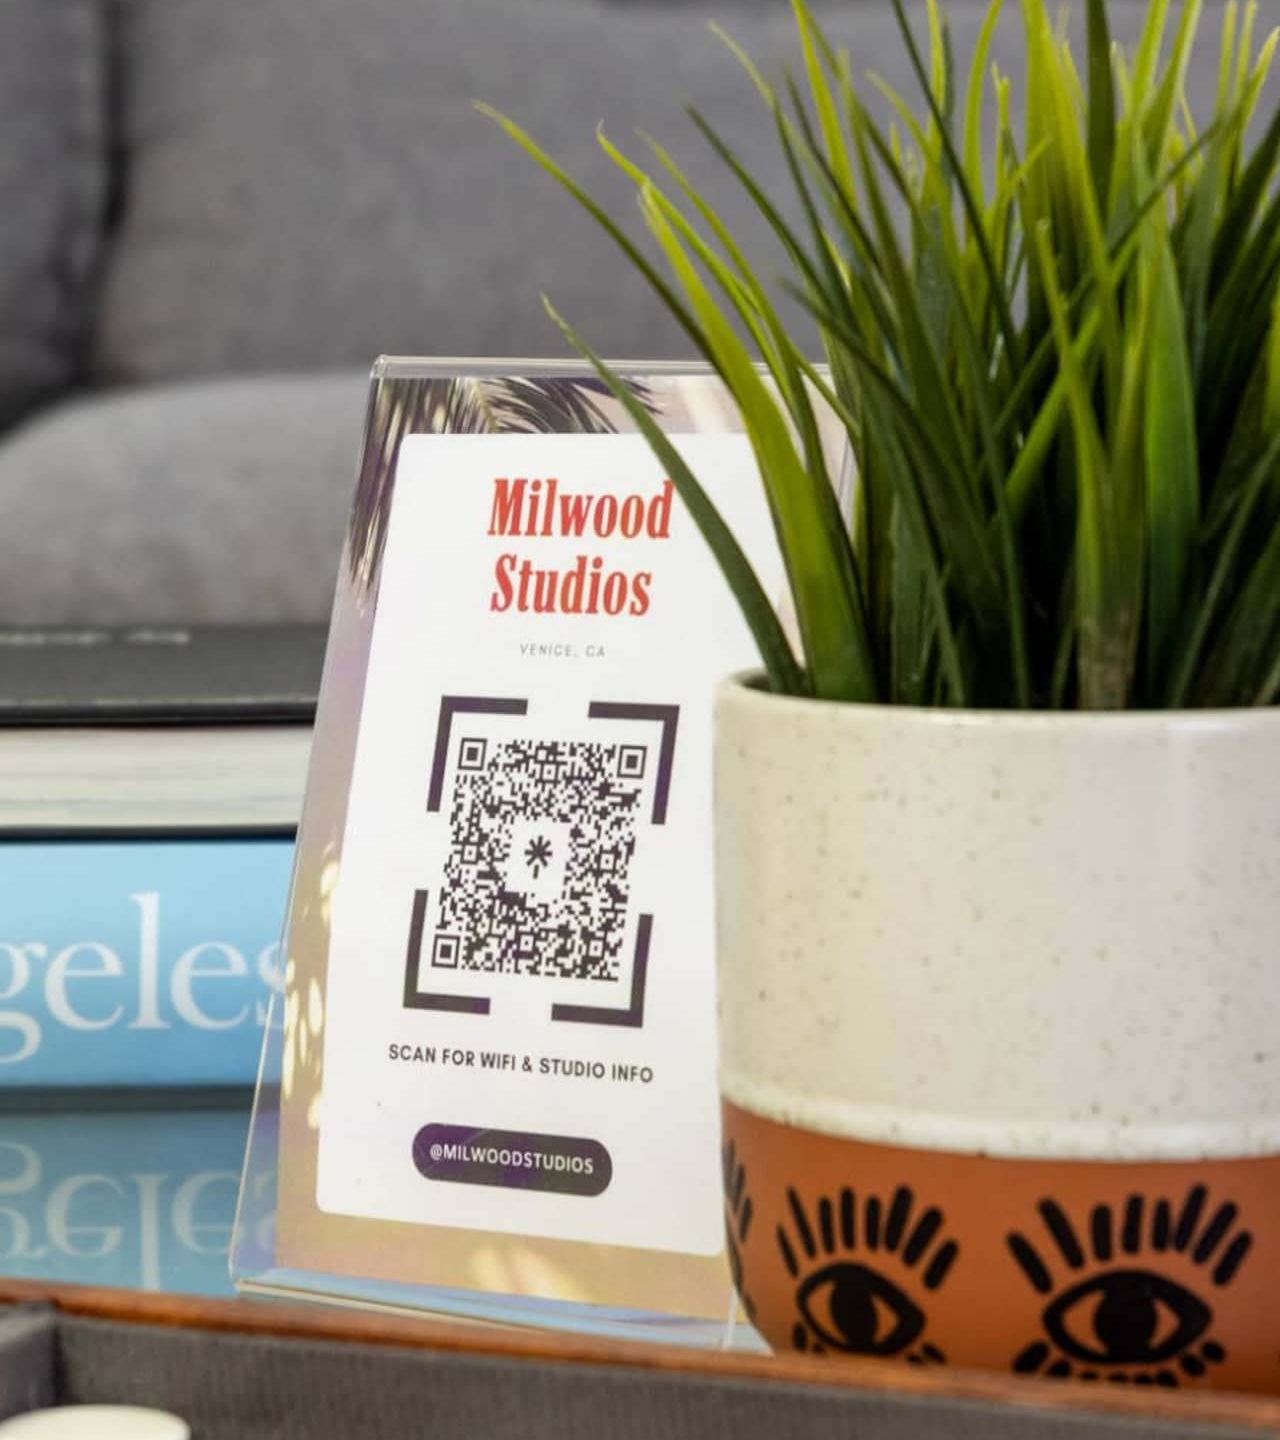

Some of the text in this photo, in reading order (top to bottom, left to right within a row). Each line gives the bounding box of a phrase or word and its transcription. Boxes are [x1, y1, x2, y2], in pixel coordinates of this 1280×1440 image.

[487, 478, 674, 539] Milwood
[490, 553, 652, 617] Studios
[585, 645, 606, 658] CA
[388, 1043, 654, 1083] SCAN FOR WIFI & STUDIO INFO
[429, 1143, 594, 1175] @MILWOODSTUDIOS
